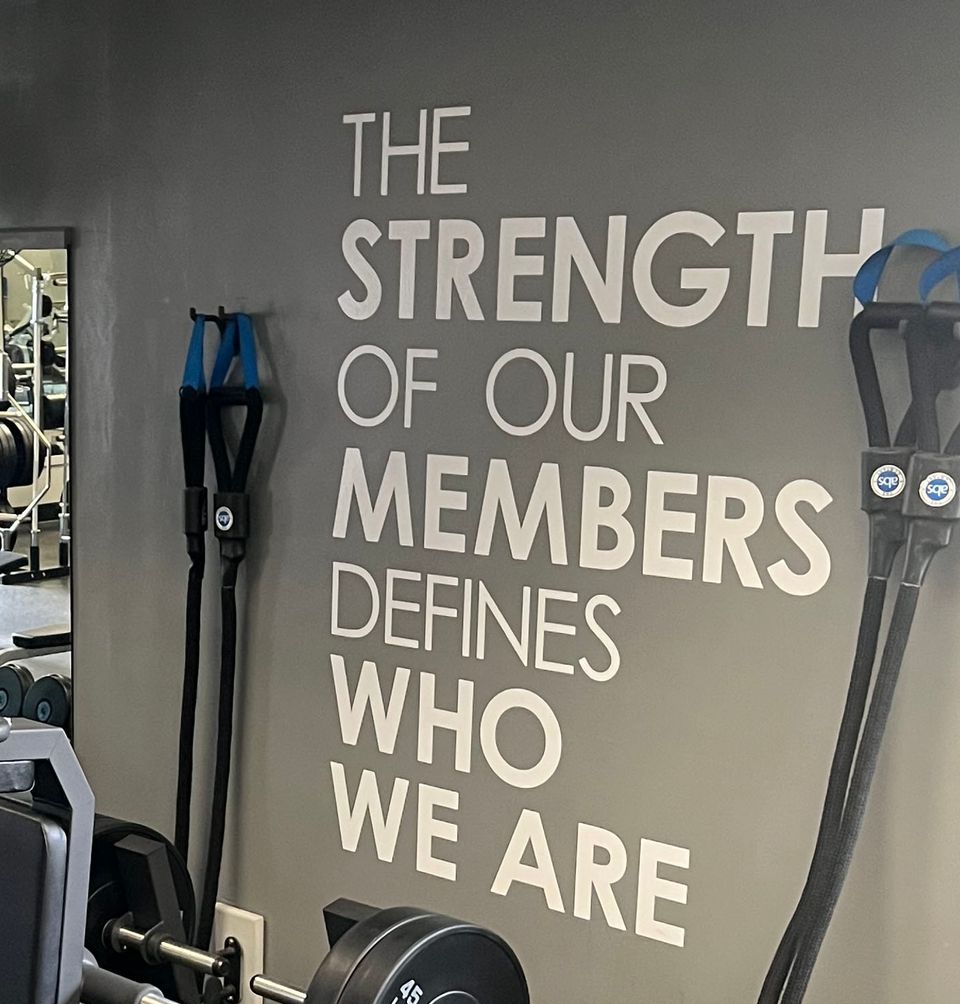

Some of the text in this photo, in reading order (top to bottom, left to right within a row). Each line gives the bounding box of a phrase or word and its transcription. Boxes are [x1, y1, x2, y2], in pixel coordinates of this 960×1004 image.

[343, 106, 471, 197] THE
[337, 207, 885, 328] STRENGTH
[338, 345, 668, 445] OF OUR
[332, 447, 834, 596] MEMBERS
[330, 561, 622, 682] DEFINES
[330, 653, 563, 789] WHO
[330, 761, 691, 949] WE ARE
